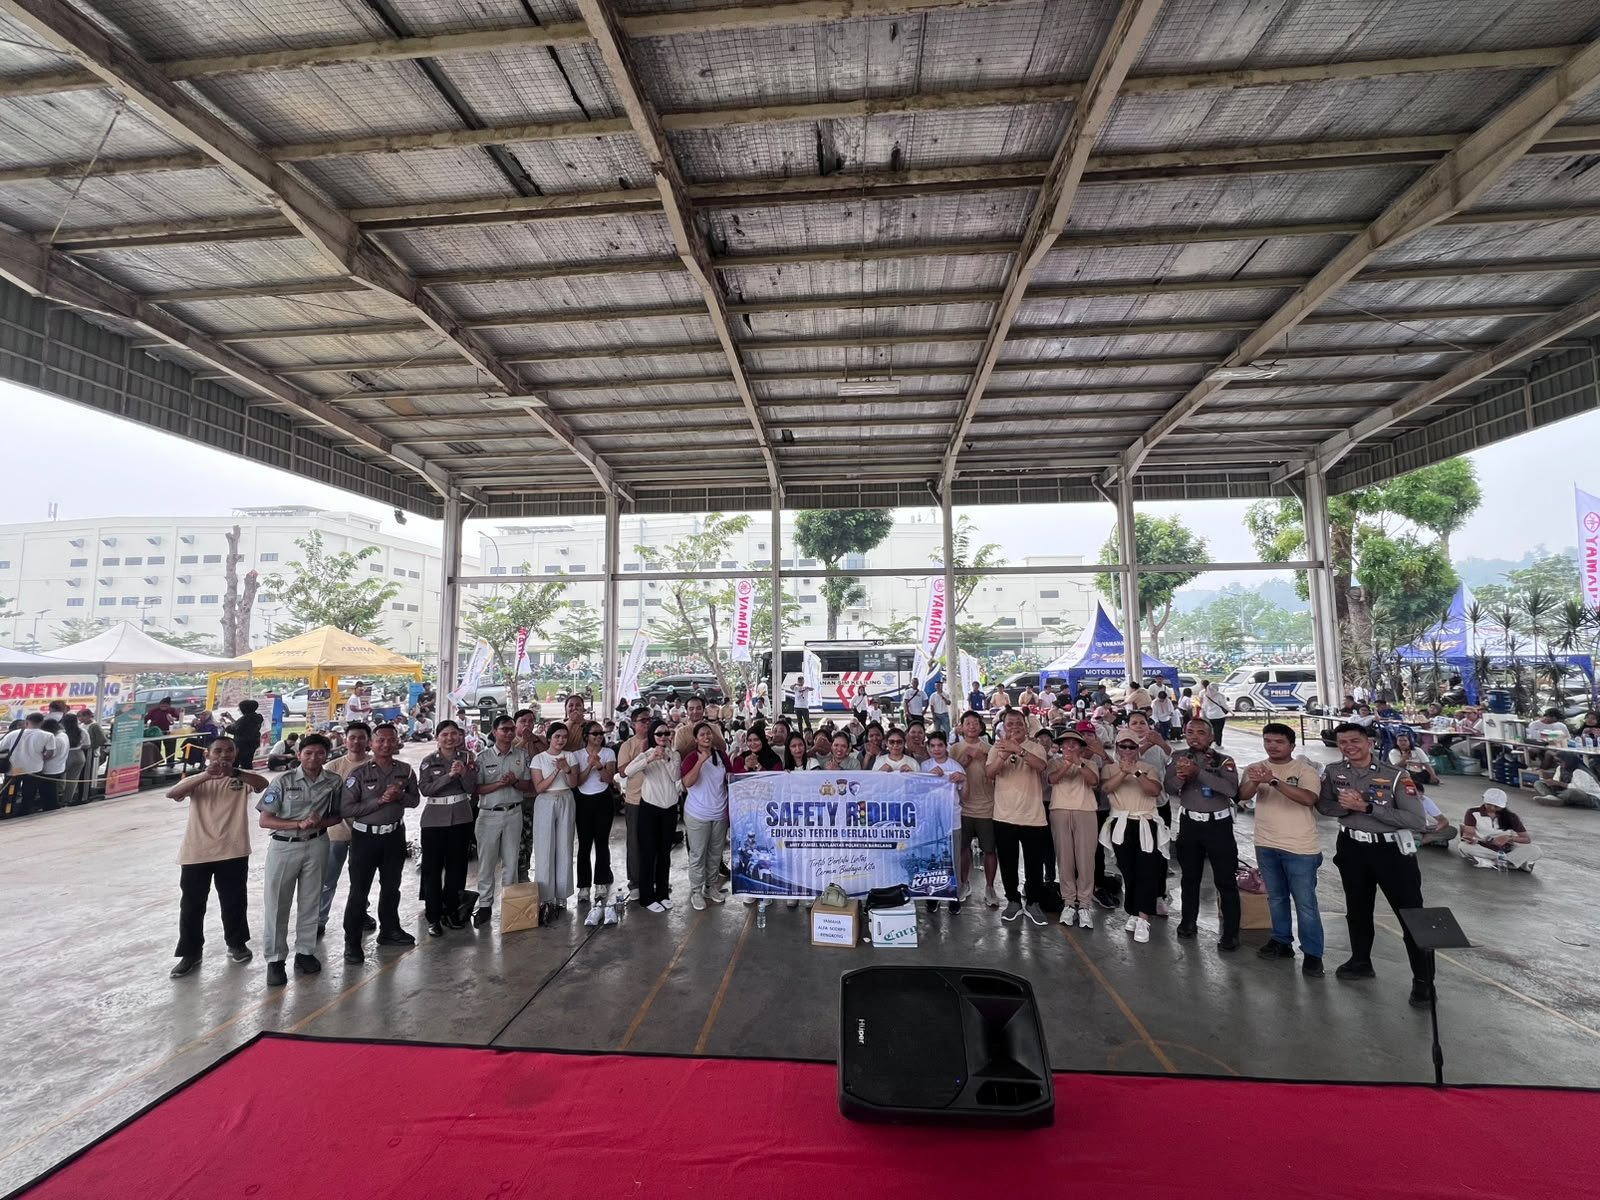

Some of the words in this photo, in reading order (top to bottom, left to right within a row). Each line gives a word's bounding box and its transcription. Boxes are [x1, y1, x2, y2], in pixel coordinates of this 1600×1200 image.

[1585, 535, 1600, 604] YAMA
[736, 596, 750, 646] YAMAHA
[928, 594, 945, 644] YAMAHA
[0, 682, 68, 699] SAFETY
[766, 801, 839, 827] SAFETY
[845, 800, 916, 827] RIDING
[771, 829, 807, 838] EDUKASI
[809, 829, 839, 838] TERTIB
[841, 829, 878, 838] BERLALU
[881, 829, 911, 839] LINTAS
[911, 875, 949, 888] KARIB
